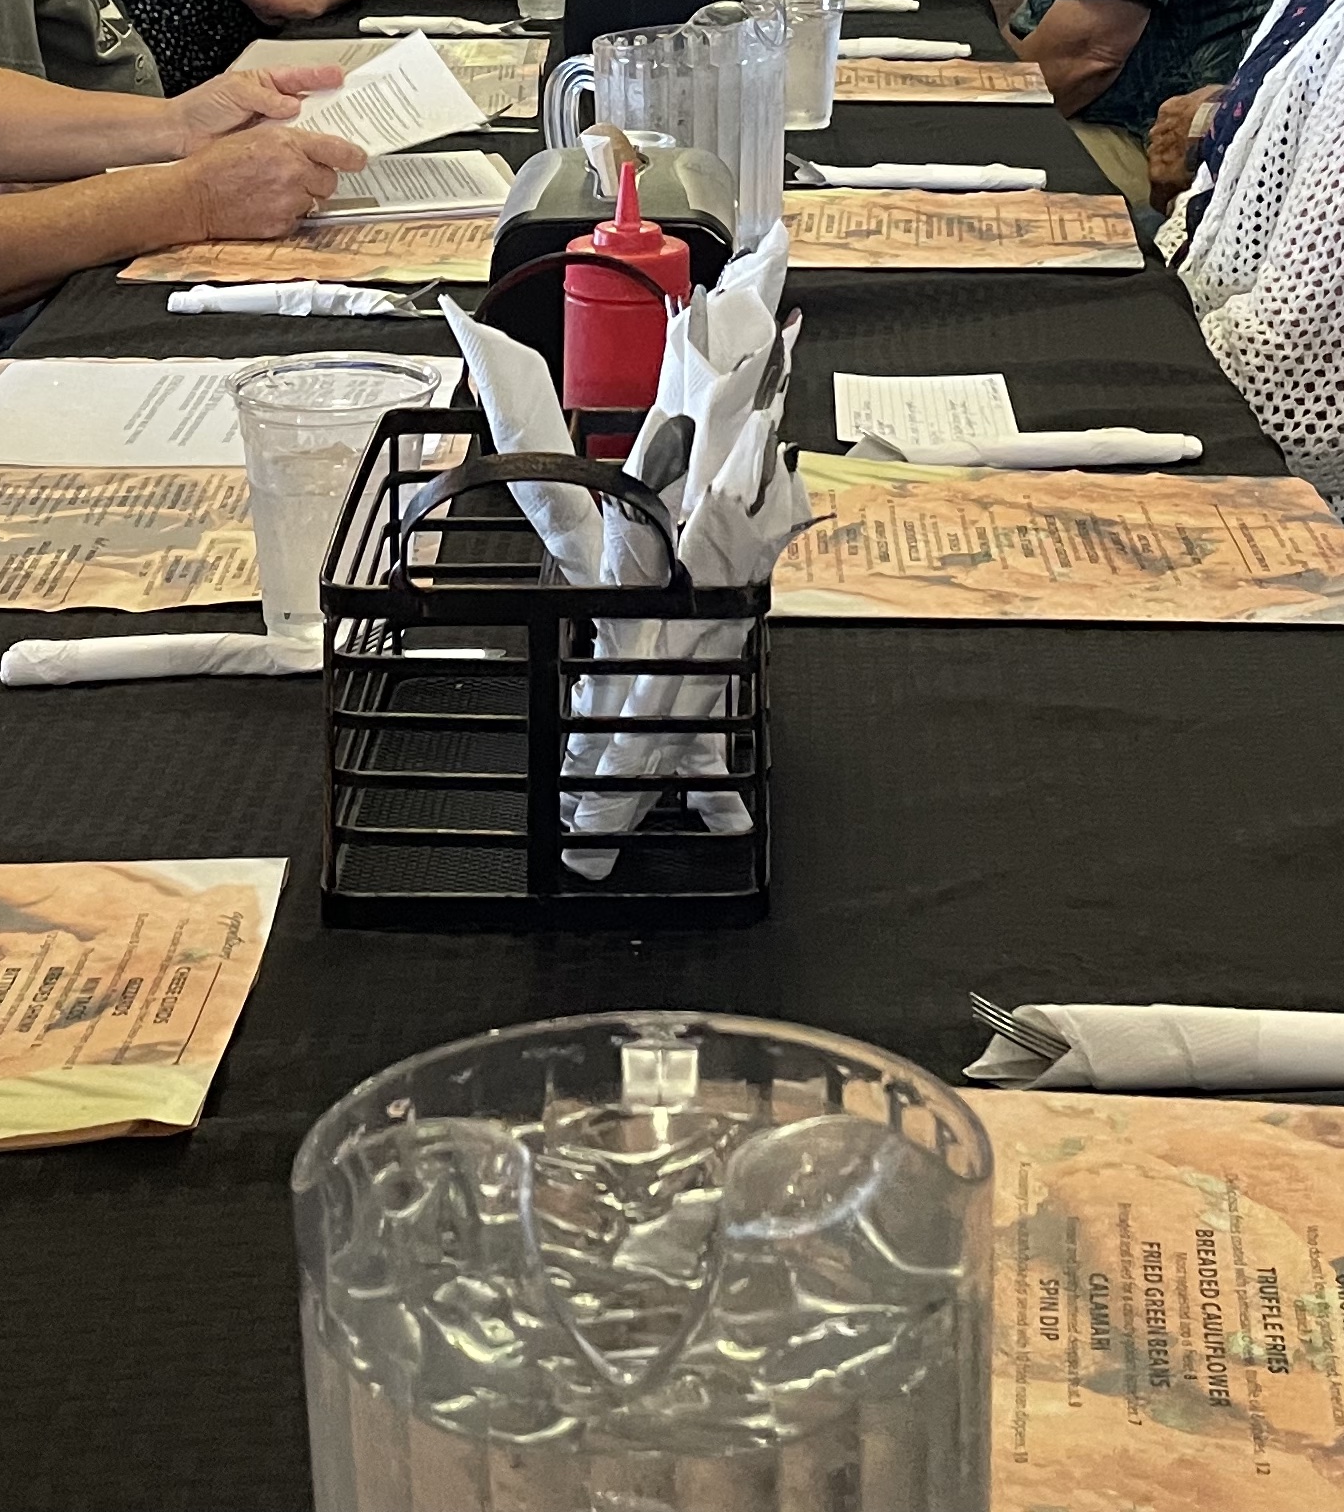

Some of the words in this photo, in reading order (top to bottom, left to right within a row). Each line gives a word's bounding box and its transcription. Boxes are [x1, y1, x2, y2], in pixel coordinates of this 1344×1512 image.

[1140, 1241, 1164, 1282] FRIED
[1193, 1229, 1221, 1298] BREADED
[1037, 1278, 1059, 1311] SPIN
[1086, 1272, 1112, 1351] CALAMARI
[1143, 1287, 1168, 1334] GREEN
[1254, 1267, 1284, 1330] TRUFFLE
[1038, 1315, 1060, 1341] DIP
[1146, 1338, 1171, 1387] BEANS
[1199, 1302, 1233, 1407] CAULIFLOWER
[1262, 1334, 1290, 1374] FRIES
[1254, 1462, 1271, 1475] 12
